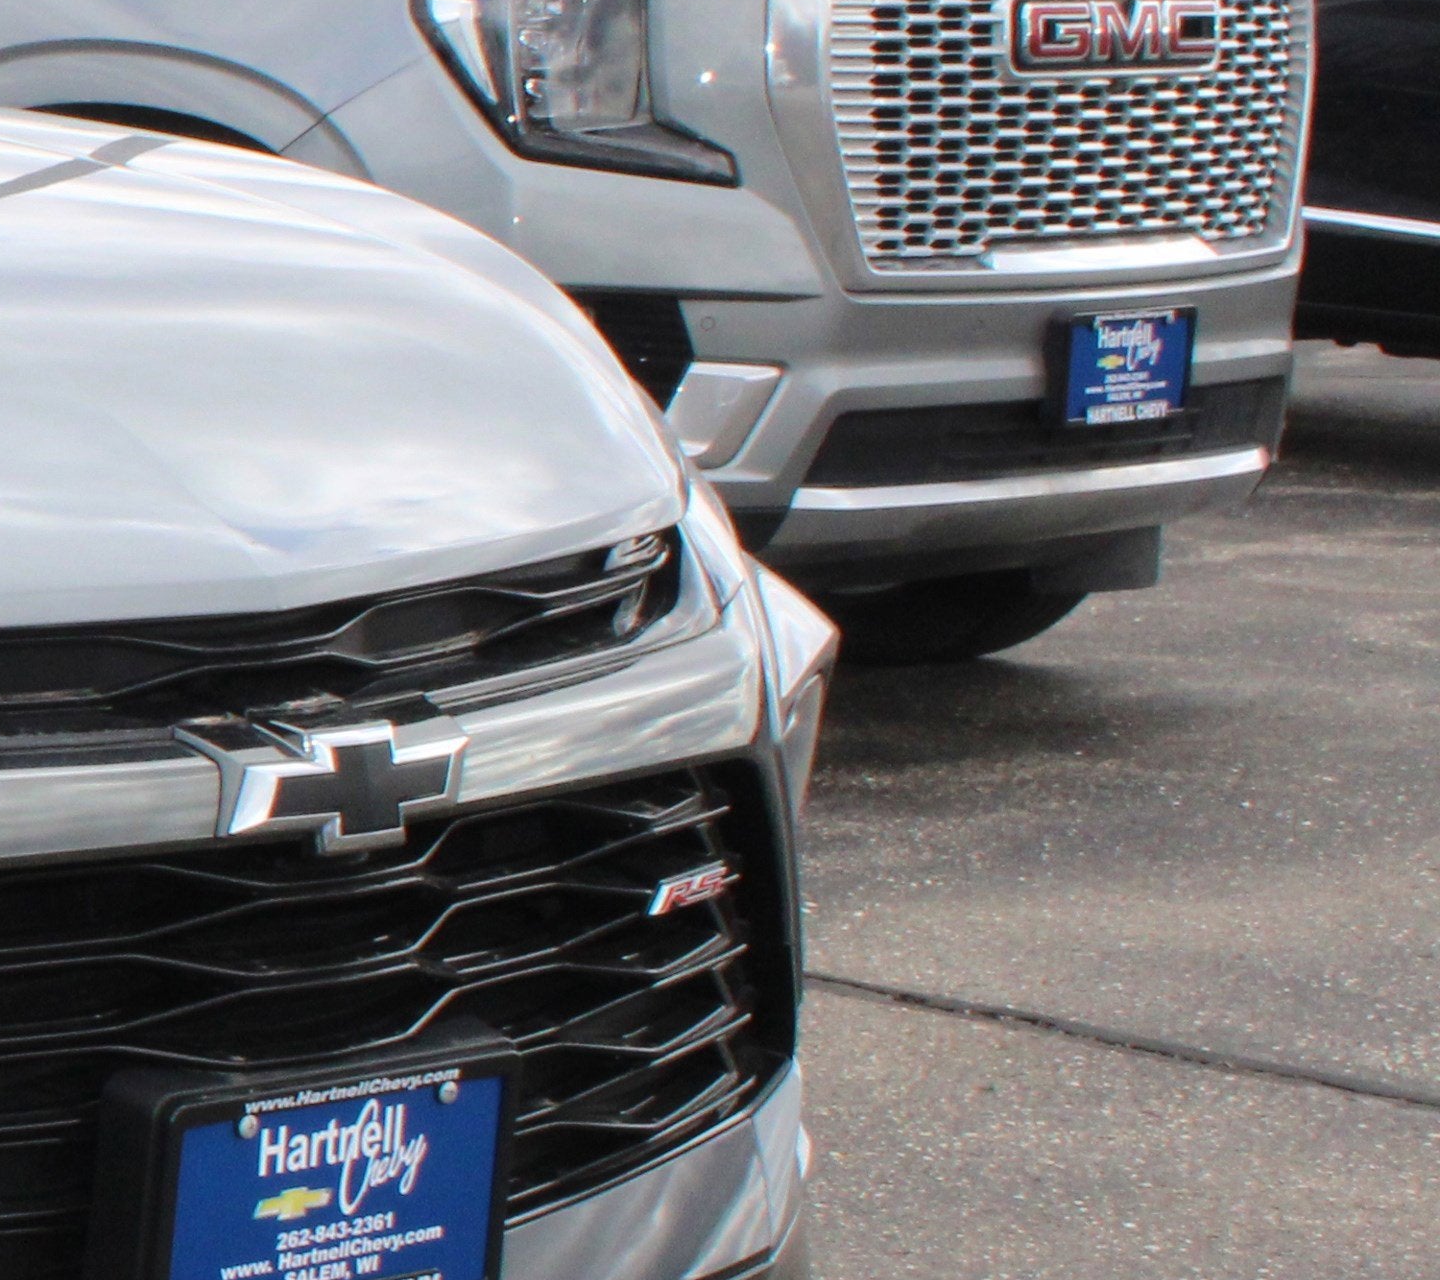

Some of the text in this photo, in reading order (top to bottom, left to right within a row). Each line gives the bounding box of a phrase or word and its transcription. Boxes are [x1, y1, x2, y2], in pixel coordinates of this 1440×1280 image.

[647, 860, 741, 916] RS
[244, 1068, 461, 1114] www.HartnellChevy.com
[258, 1103, 406, 1177] Hartnell
[220, 1225, 444, 1280] www. HartnellChevy.com
[275, 1211, 396, 1251] 262-843-2361
[356, 1254, 380, 1275] WI
